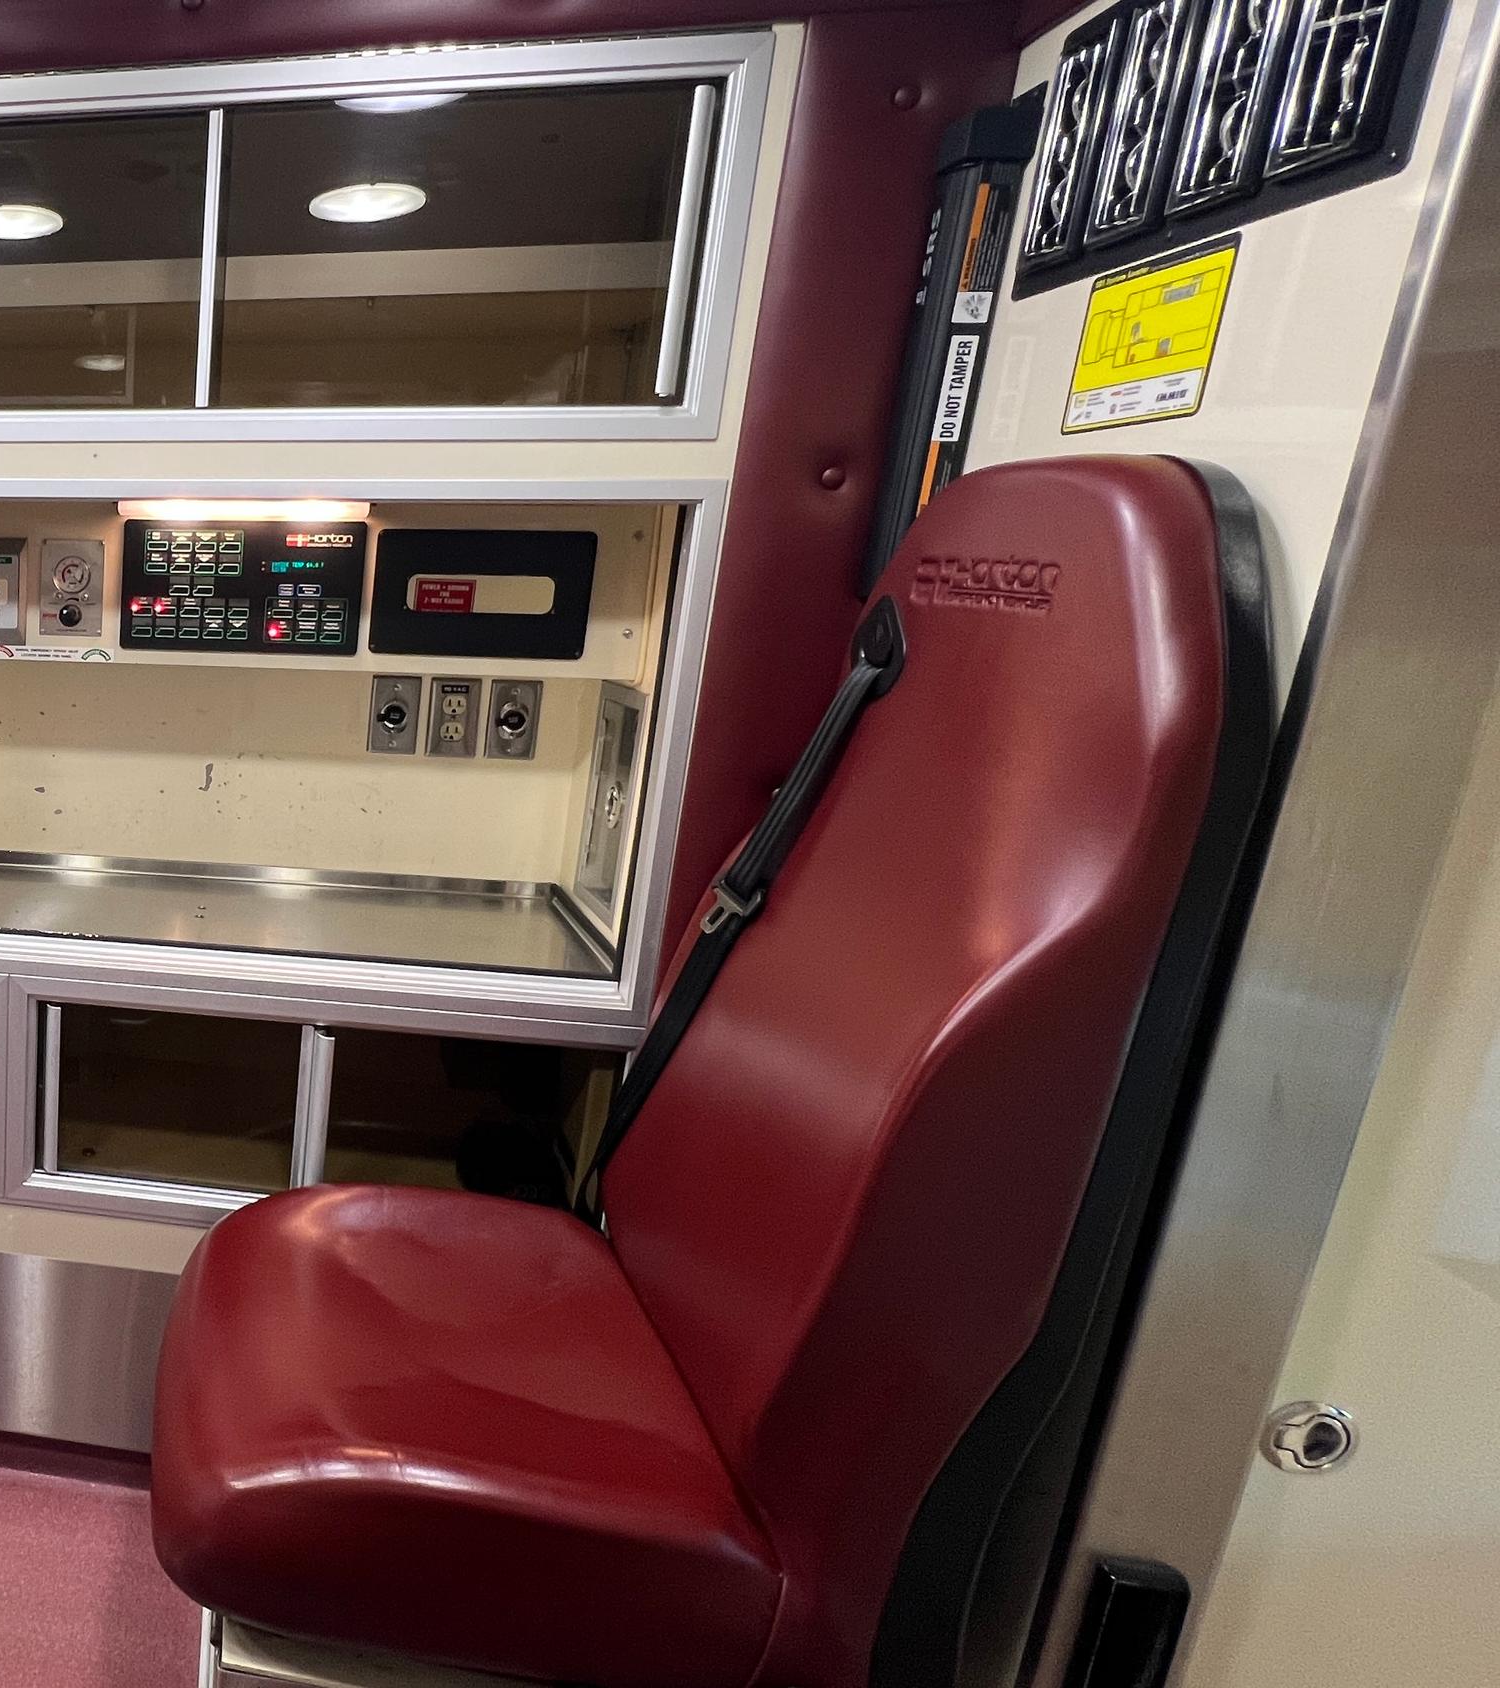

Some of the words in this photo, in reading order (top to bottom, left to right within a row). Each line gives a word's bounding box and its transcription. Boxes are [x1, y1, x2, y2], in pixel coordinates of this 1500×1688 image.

[921, 208, 942, 278] SRS
[950, 340, 975, 384] TAMPER
[945, 386, 963, 417] NOT
[940, 420, 955, 440] DO
[307, 533, 354, 544] Horton
[422, 583, 441, 591] POWER
